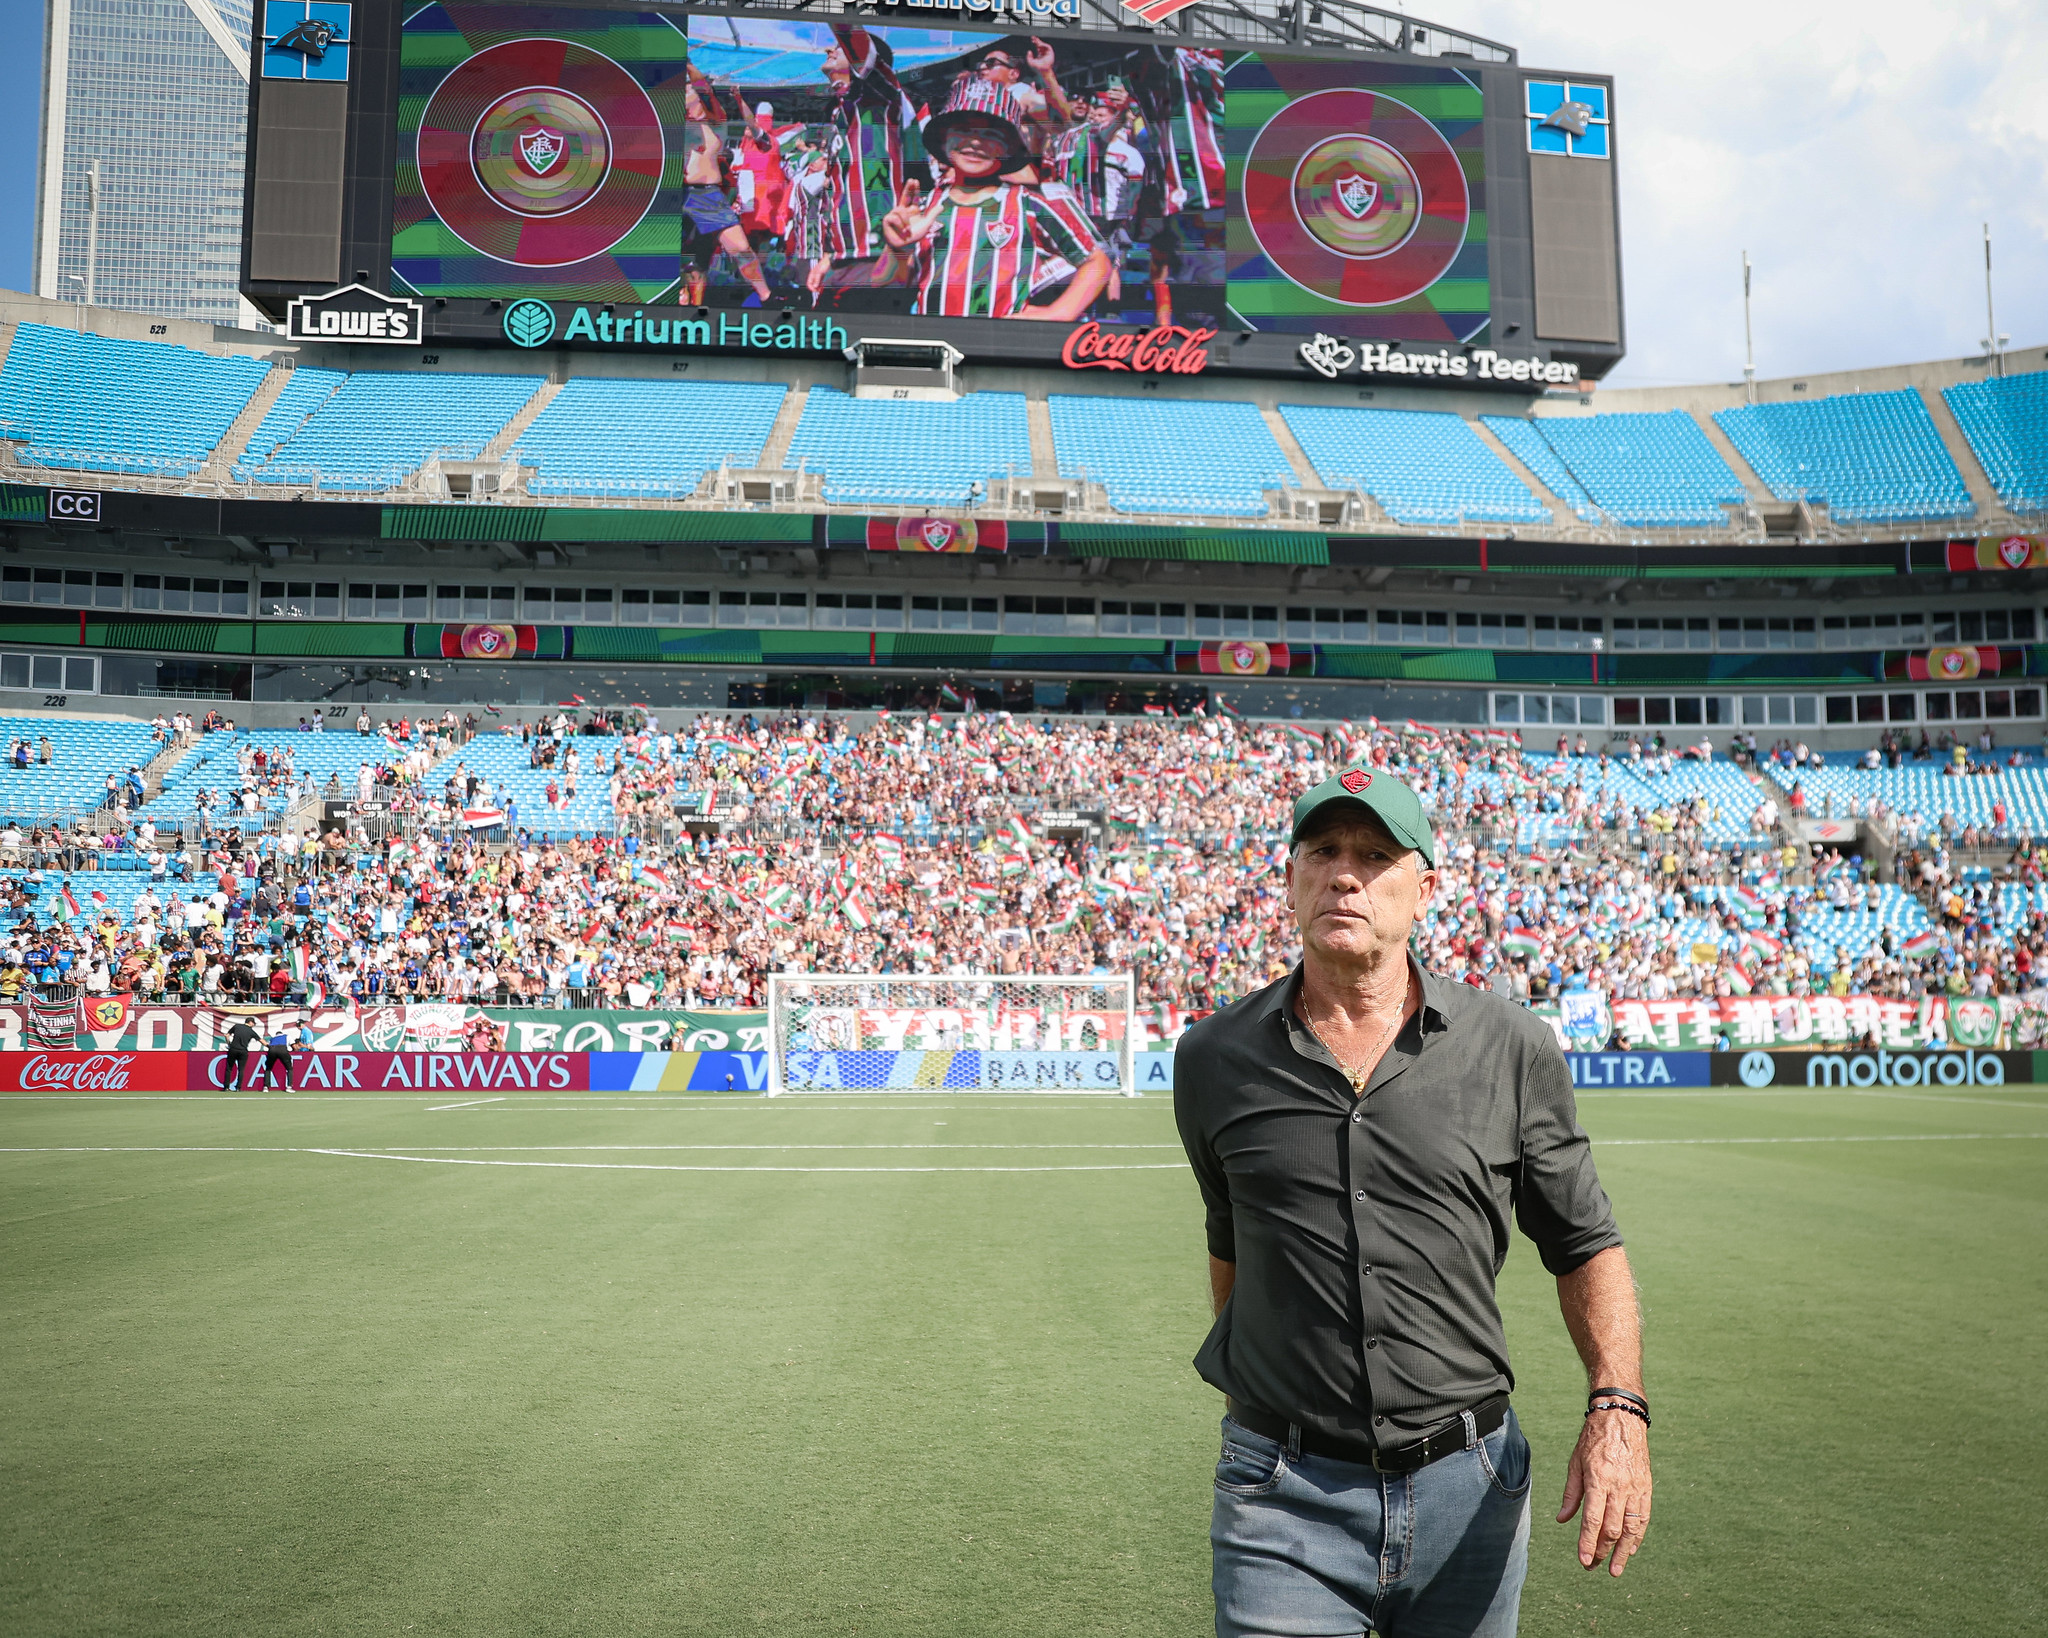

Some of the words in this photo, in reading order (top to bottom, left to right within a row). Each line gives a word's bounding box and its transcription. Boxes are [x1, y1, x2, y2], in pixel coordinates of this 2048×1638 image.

[149, 324, 167, 335] 525
[301, 305, 409, 338] LOWE'S
[563, 307, 711, 345] Atrium
[719, 312, 848, 350] Health
[1061, 321, 1219, 374] Coca-Cola
[1359, 343, 1468, 376] Harris
[1472, 349, 1579, 383] Teeter
[56, 494, 94, 516] CC
[43, 695, 67, 707] 226
[327, 706, 349, 718] 227
[363, 803, 383, 811] CLUB
[408, 1004, 443, 1021] YOUNG
[0, 1008, 183, 1052] RVO
[19, 1054, 137, 1090] Coca-Cola
[381, 1054, 571, 1089] AIRWAYS
[730, 1052, 843, 1088] VSA
[988, 1060, 1082, 1082] BANK
[1806, 1049, 2006, 1088] motorola
